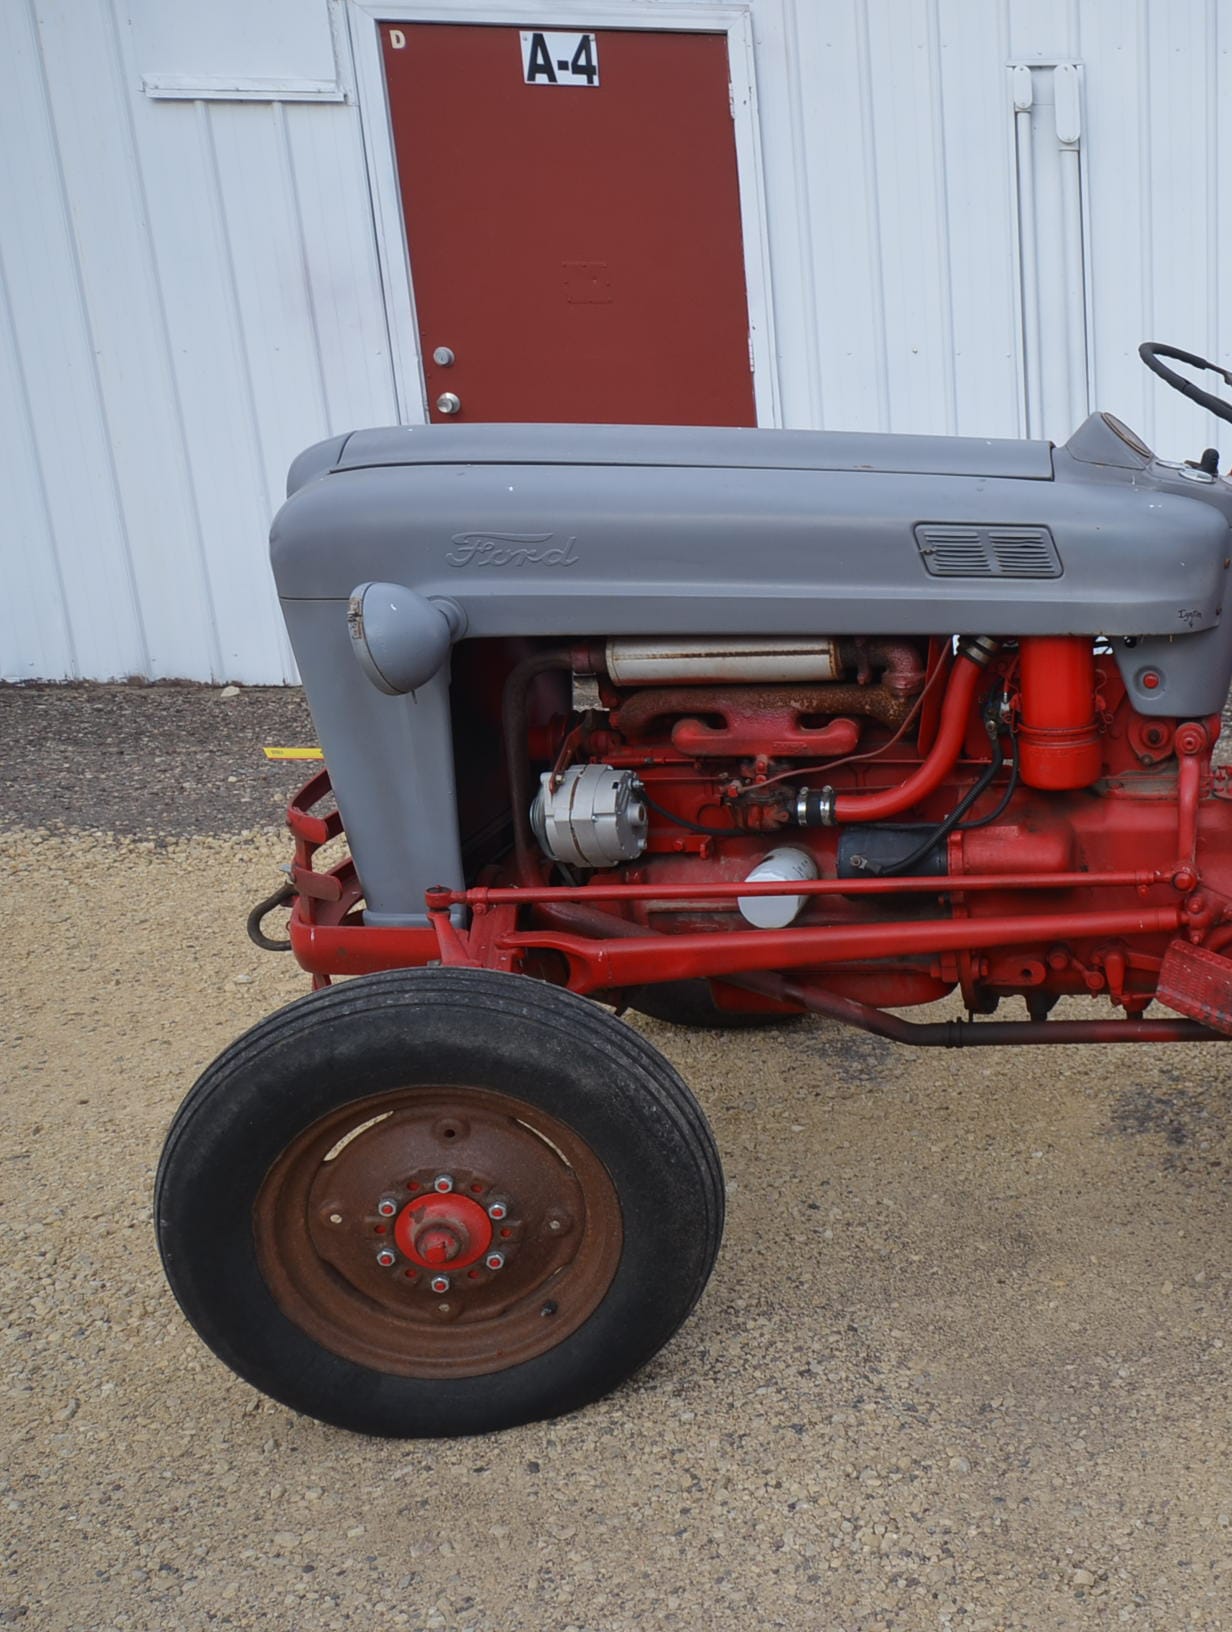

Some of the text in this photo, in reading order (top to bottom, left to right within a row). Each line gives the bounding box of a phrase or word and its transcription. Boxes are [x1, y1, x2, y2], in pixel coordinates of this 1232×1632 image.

[389, 29, 406, 48] D
[526, 32, 597, 84] A-4
[446, 531, 580, 567] Ford
